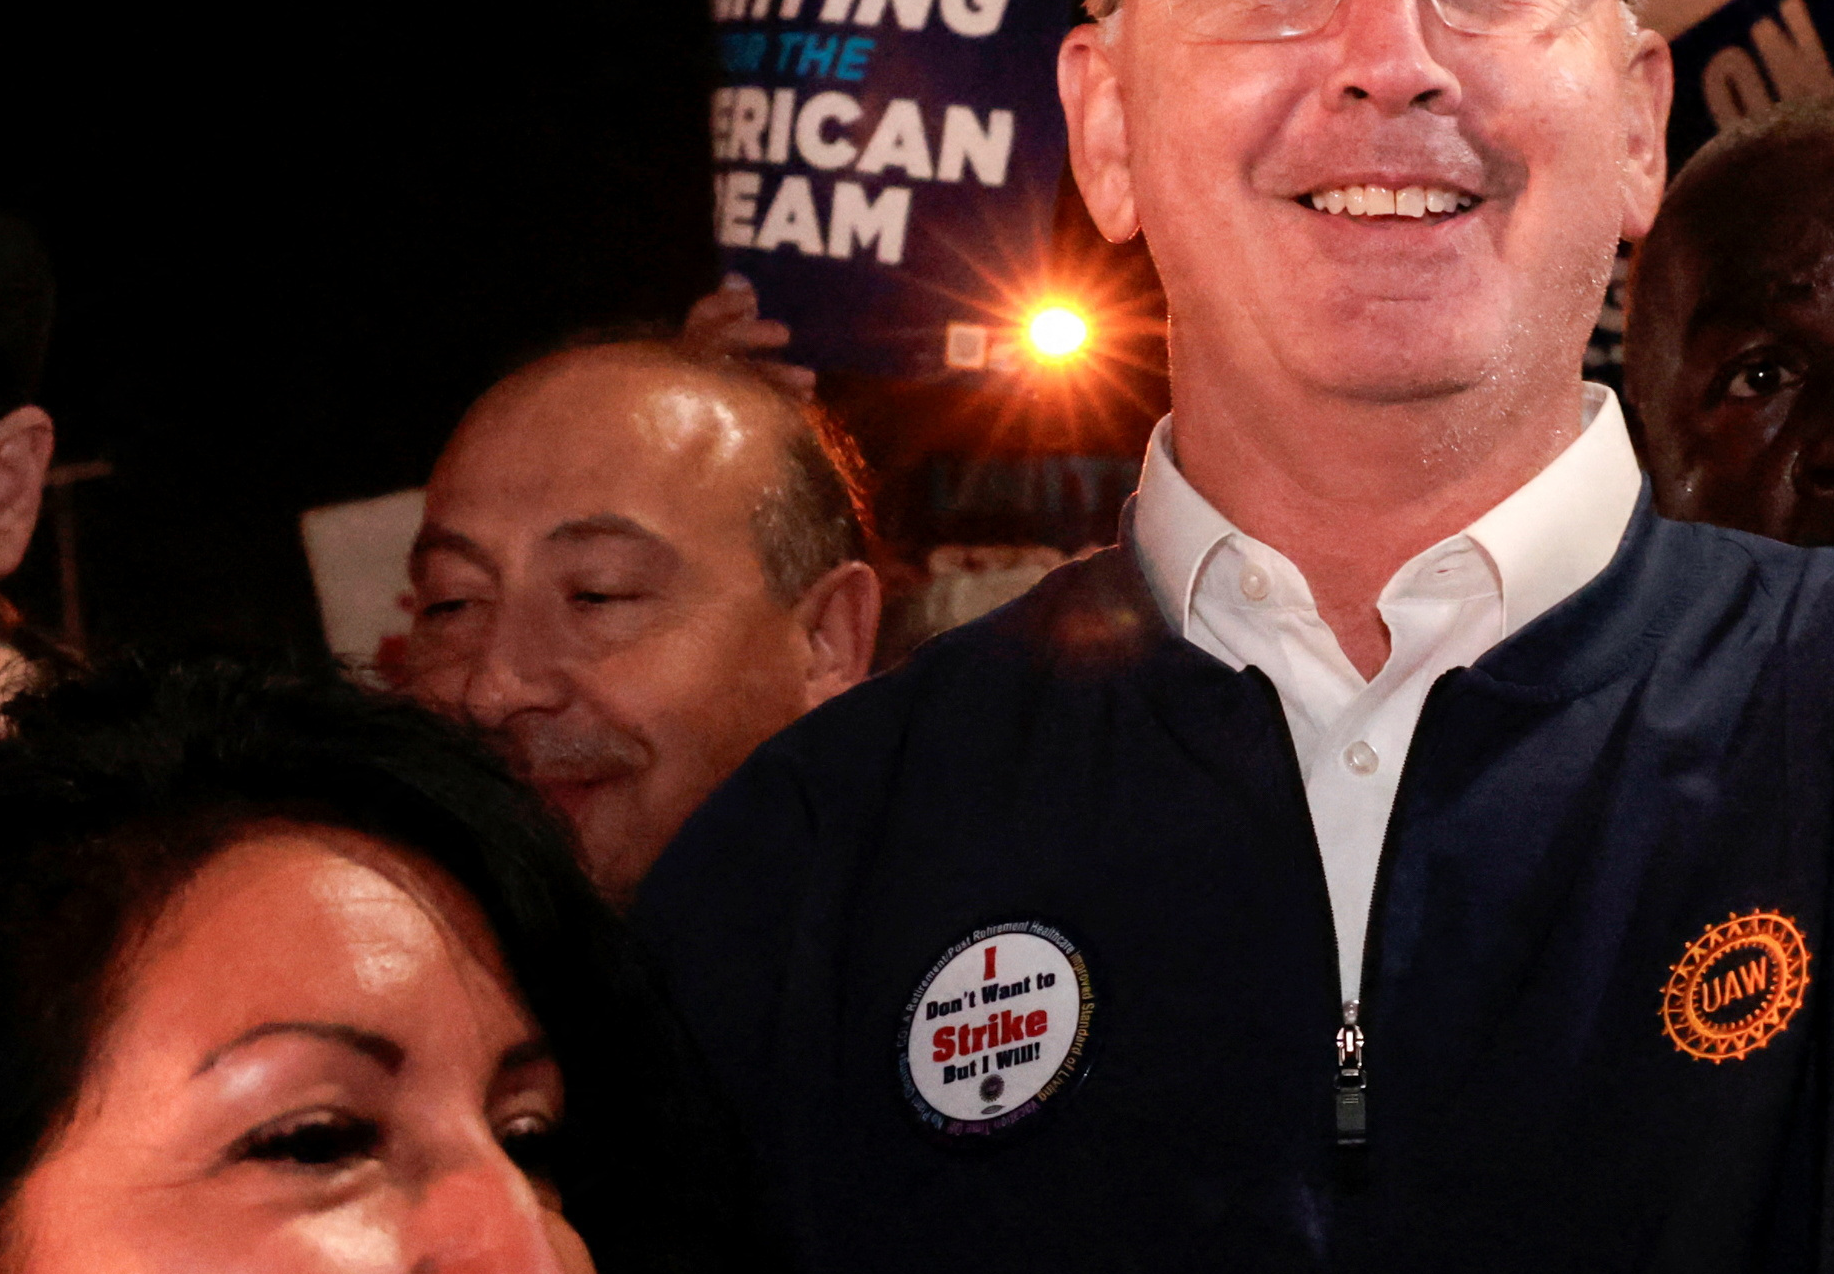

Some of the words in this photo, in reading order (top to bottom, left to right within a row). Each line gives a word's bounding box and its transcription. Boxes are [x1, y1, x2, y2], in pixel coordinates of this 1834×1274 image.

[775, 31, 876, 82] THE
[1028, 920, 1076, 955] Healthcare
[983, 945, 997, 981] I
[1701, 956, 1767, 1013] UAW
[925, 990, 976, 1021] Don't
[981, 975, 1031, 1004] Want
[1036, 972, 1056, 990] to
[932, 1009, 1049, 1063] Strike
[943, 1059, 977, 1085] But
[982, 1055, 989, 1074] I
[995, 1041, 1041, 1070] Will!
